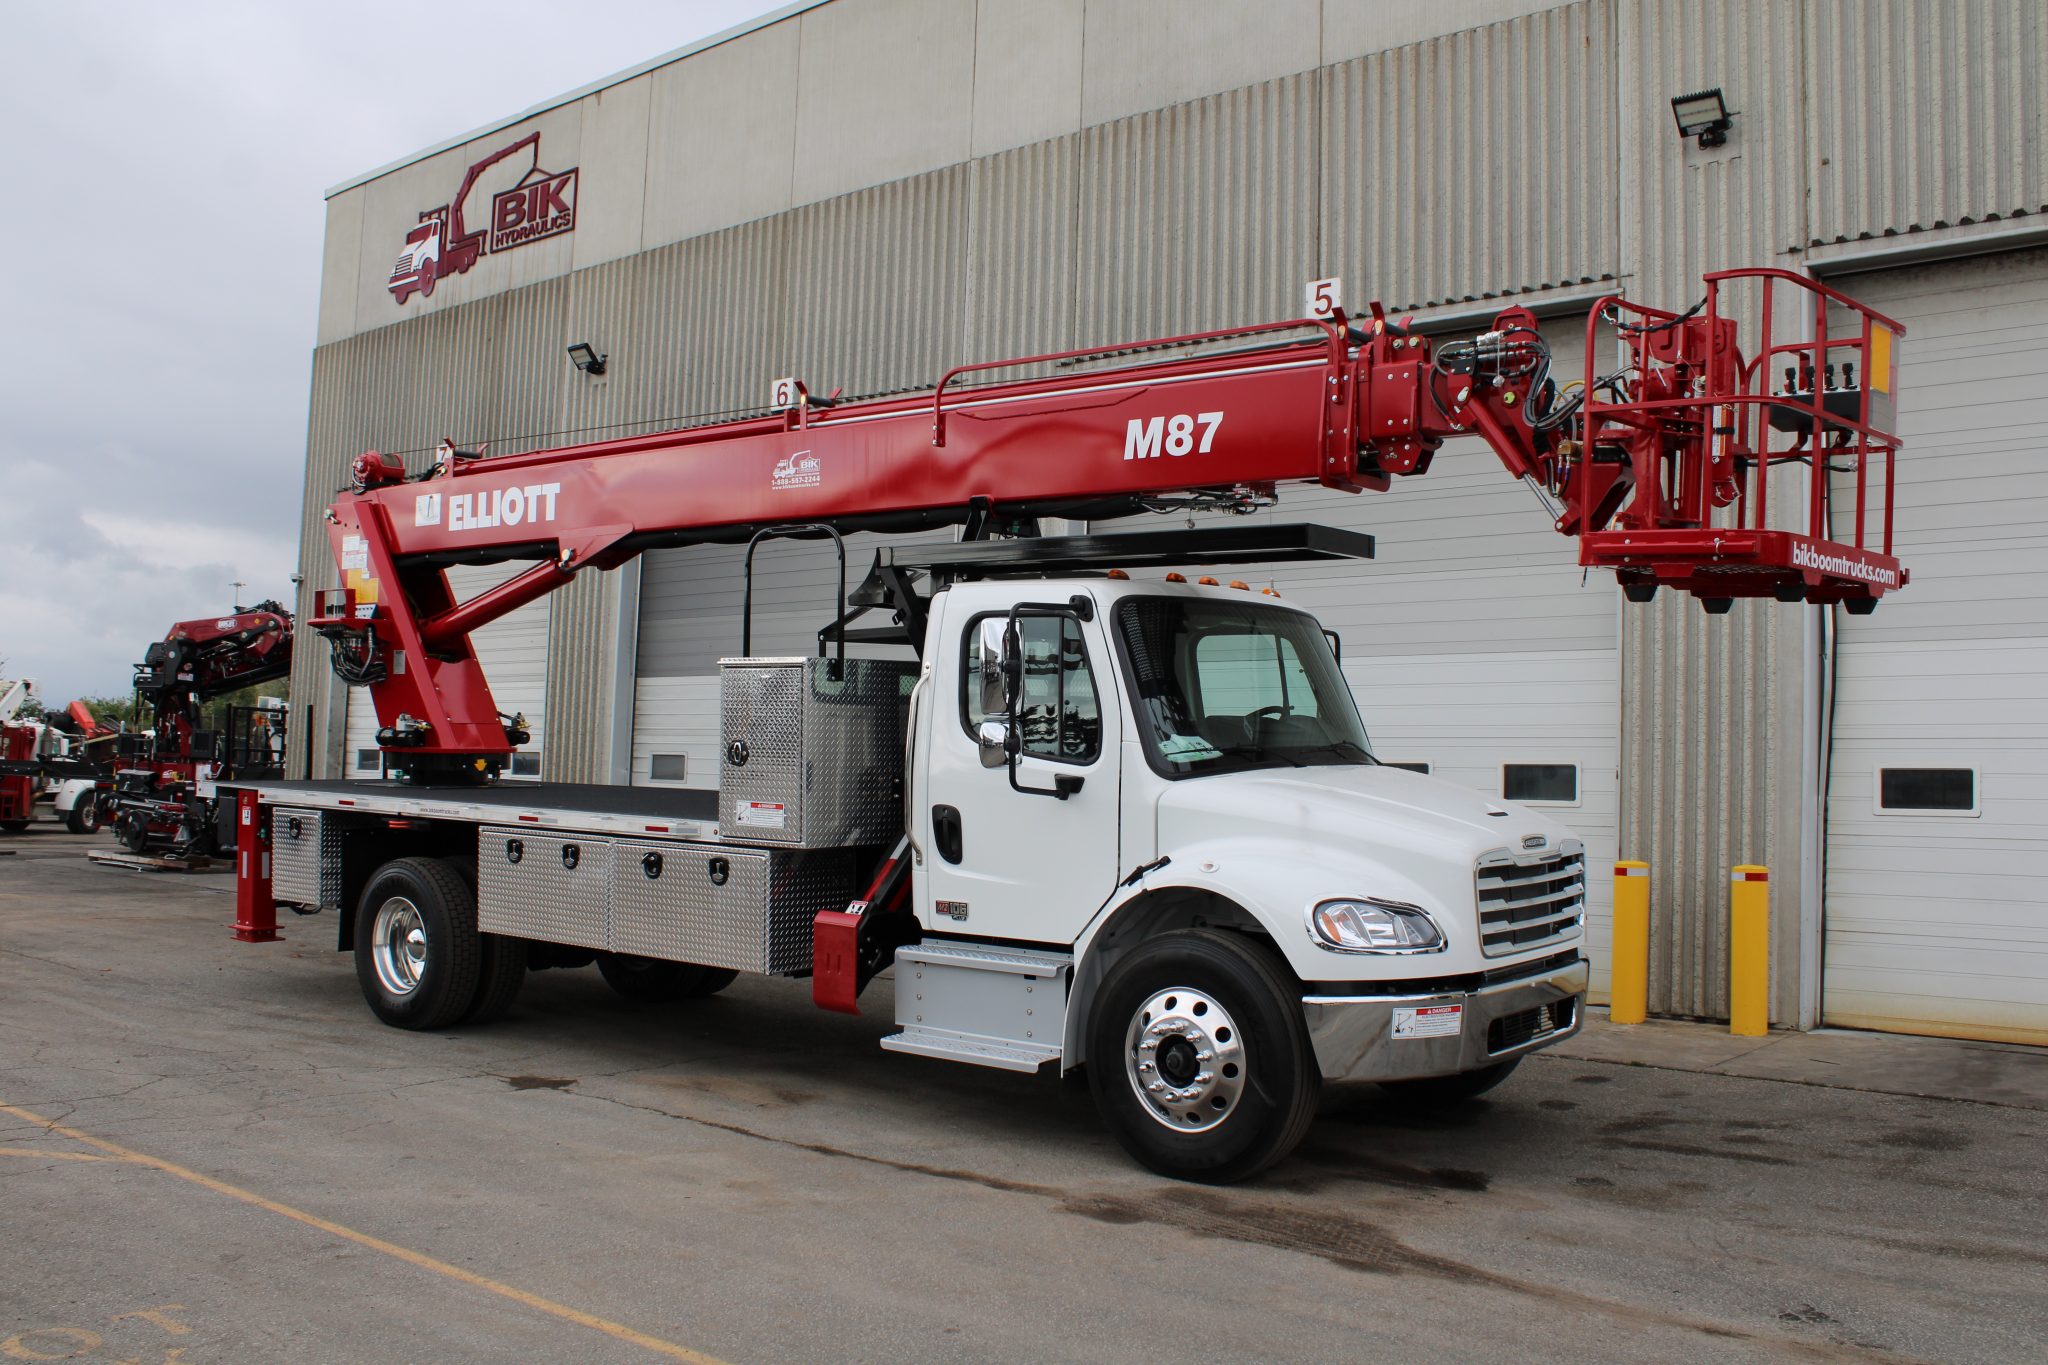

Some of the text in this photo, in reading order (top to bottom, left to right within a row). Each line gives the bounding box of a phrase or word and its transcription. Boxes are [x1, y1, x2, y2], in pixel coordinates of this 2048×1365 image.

[497, 175, 571, 232] BIK
[495, 212, 571, 248] HYDRAULICS
[1314, 282, 1333, 315] 5
[777, 382, 788, 407] 6
[1123, 411, 1224, 460] M87
[800, 460, 818, 469] BIK
[448, 482, 561, 531] ELLIOTT
[1793, 541, 1895, 585] bikboomtrucks.com
[950, 902, 967, 915] 106
